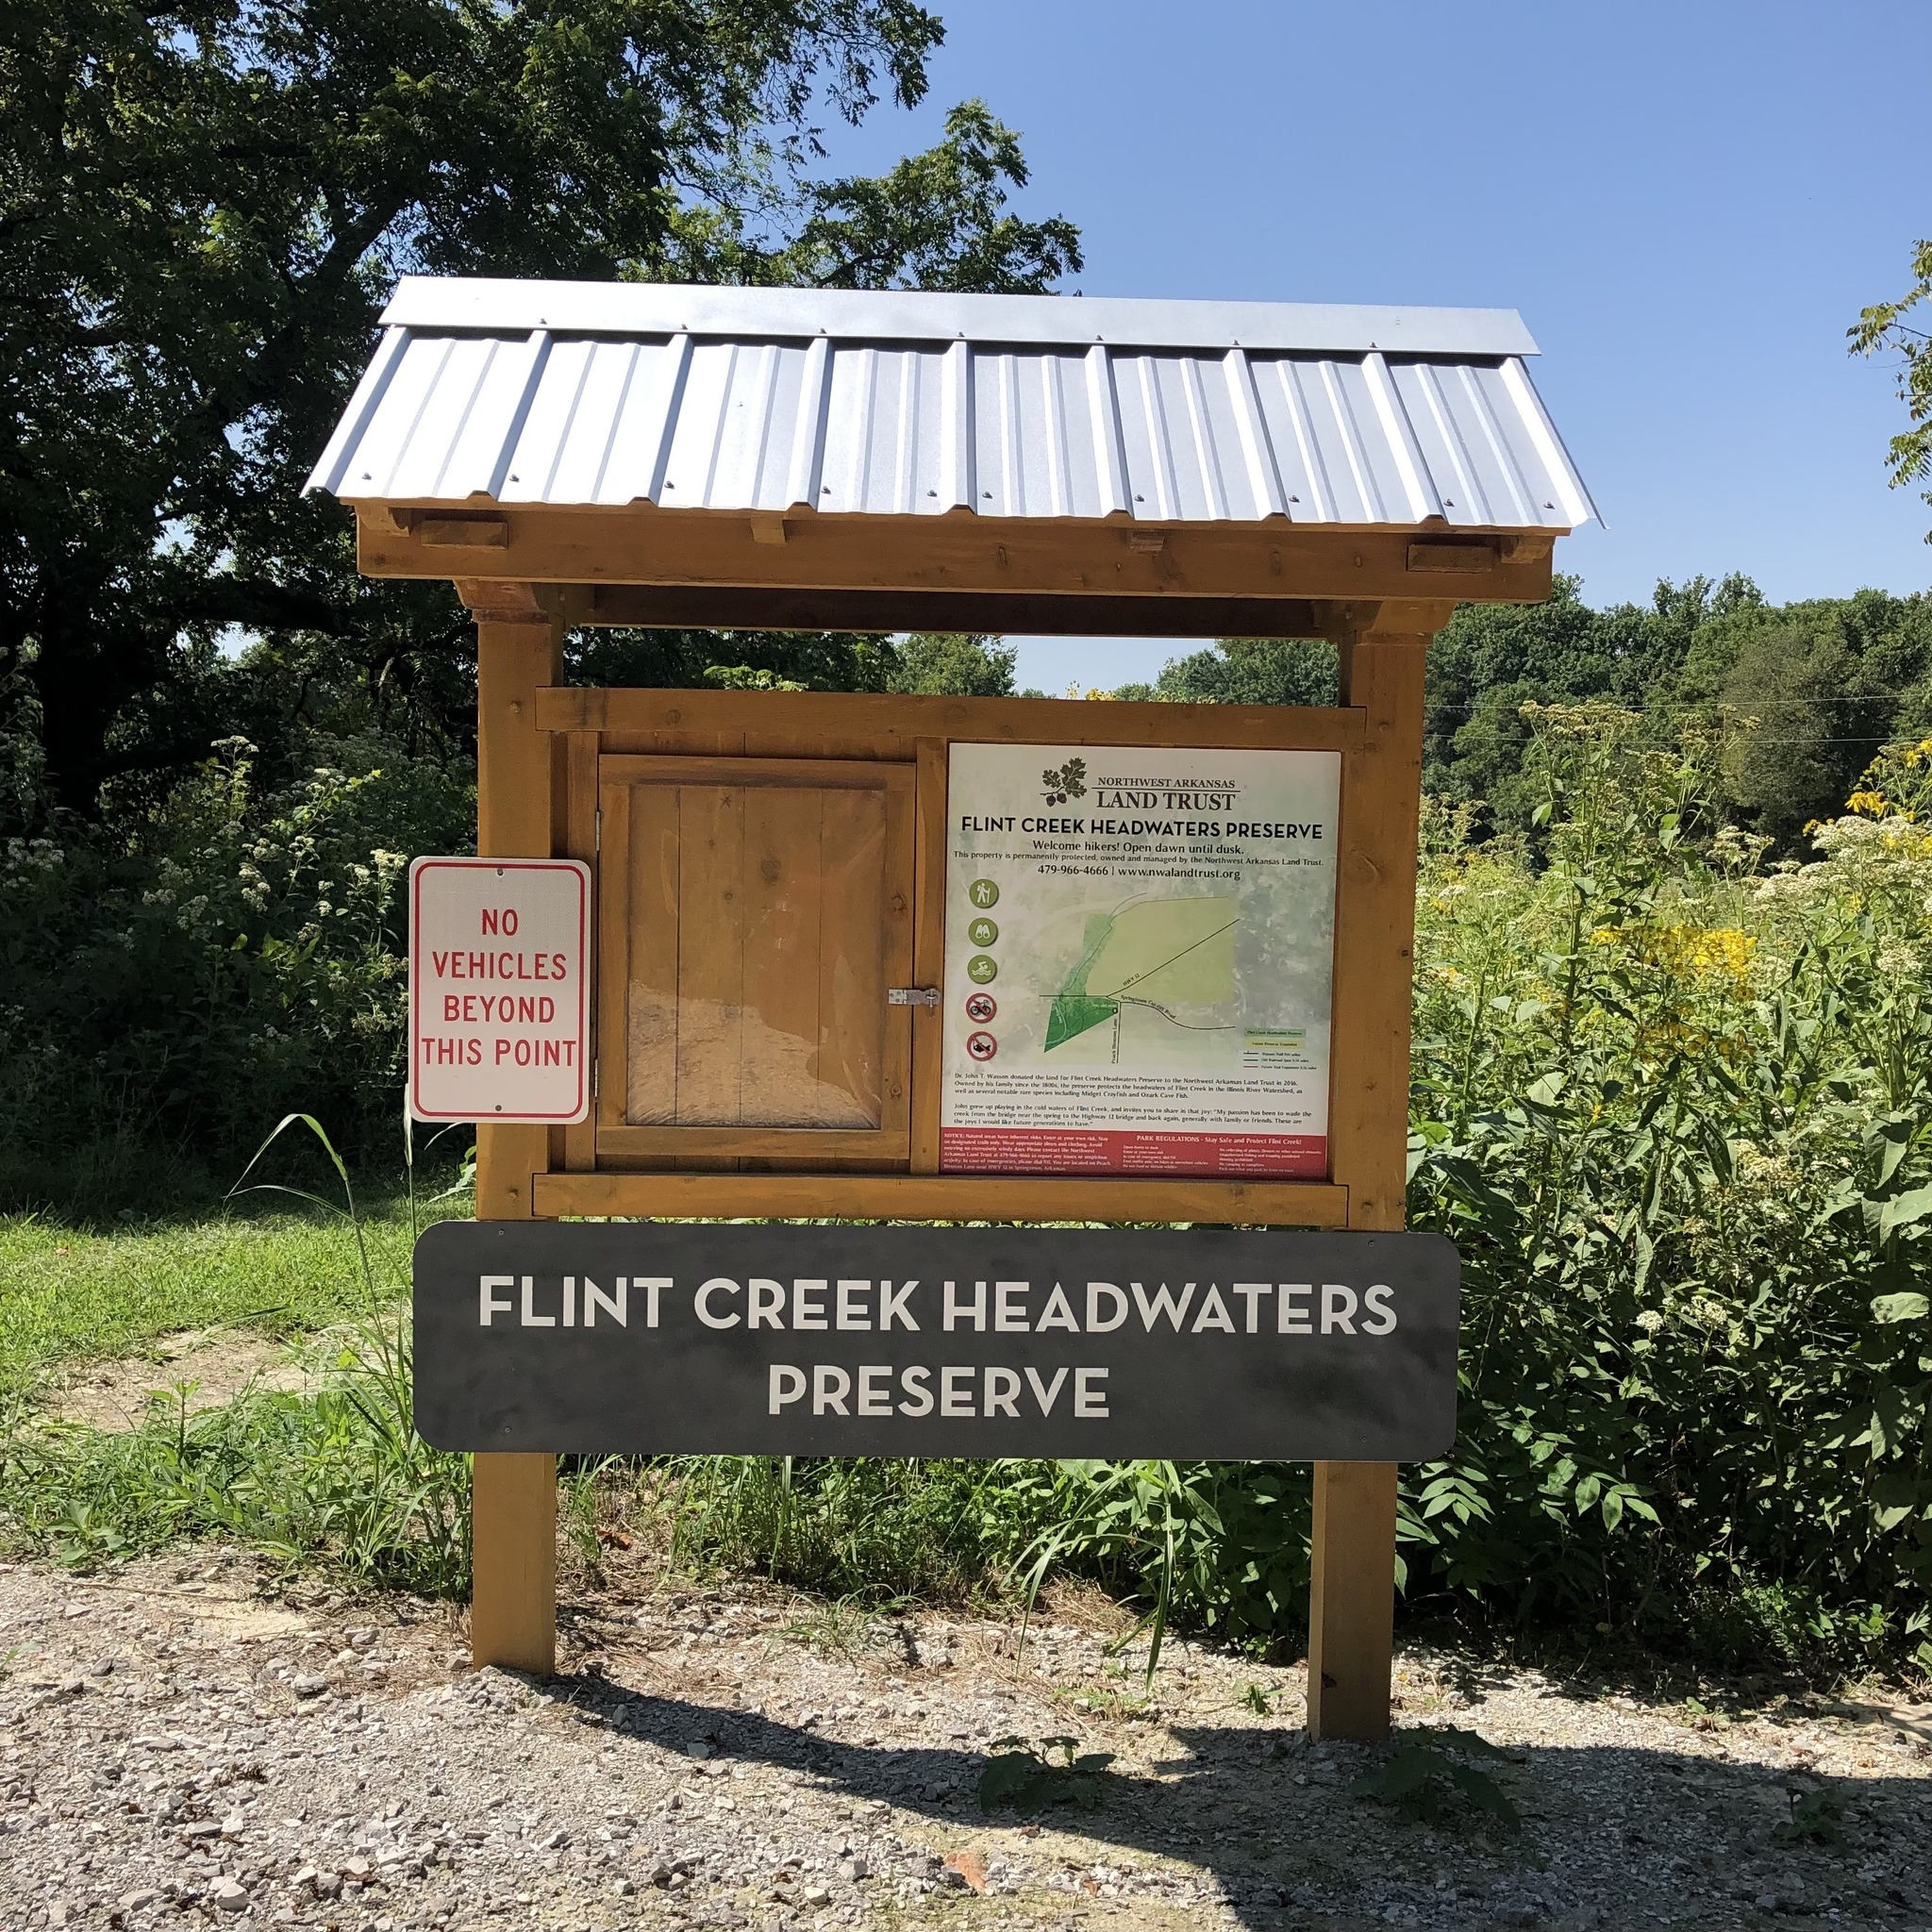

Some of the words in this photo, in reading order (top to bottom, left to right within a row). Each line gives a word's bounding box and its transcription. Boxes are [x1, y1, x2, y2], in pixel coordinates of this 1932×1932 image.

[1097, 777, 1172, 787] NORTHWEST
[1173, 778, 1235, 788] ARKANSAS
[1096, 791, 1158, 808] LAND
[1162, 791, 1235, 810] TRUST
[961, 816, 1015, 831] FLINT
[1021, 817, 1084, 833] CREEK
[1091, 819, 1220, 837] HEADWATERS
[1226, 822, 1322, 839] PRESERVE
[1012, 852, 1058, 861] permanently
[1061, 853, 1097, 861] protected,
[1143, 855, 1176, 864] managed
[1178, 856, 1188, 864] by
[1032, 840, 1080, 850] Welcome
[1085, 841, 1119, 851] hikers!
[1123, 841, 1151, 854] Open
[1155, 842, 1185, 853] dawn
[1189, 843, 1212, 853] until
[1216, 844, 1243, 854] dusk.
[1038, 864, 1108, 874] 479-966-4666
[1118, 866, 1240, 880] www.nwalandtrust.org
[481, 908, 518, 936] NO
[432, 951, 567, 980] VEHICLES
[443, 994, 555, 1024] BEYOND
[421, 1038, 482, 1066] THIS
[494, 1039, 576, 1067] POINT
[479, 1275, 674, 1328] FLINT
[693, 1277, 921, 1331] CREEK
[943, 1281, 1397, 1336] HEADWATERS
[768, 1364, 1109, 1418] PRESERVE
